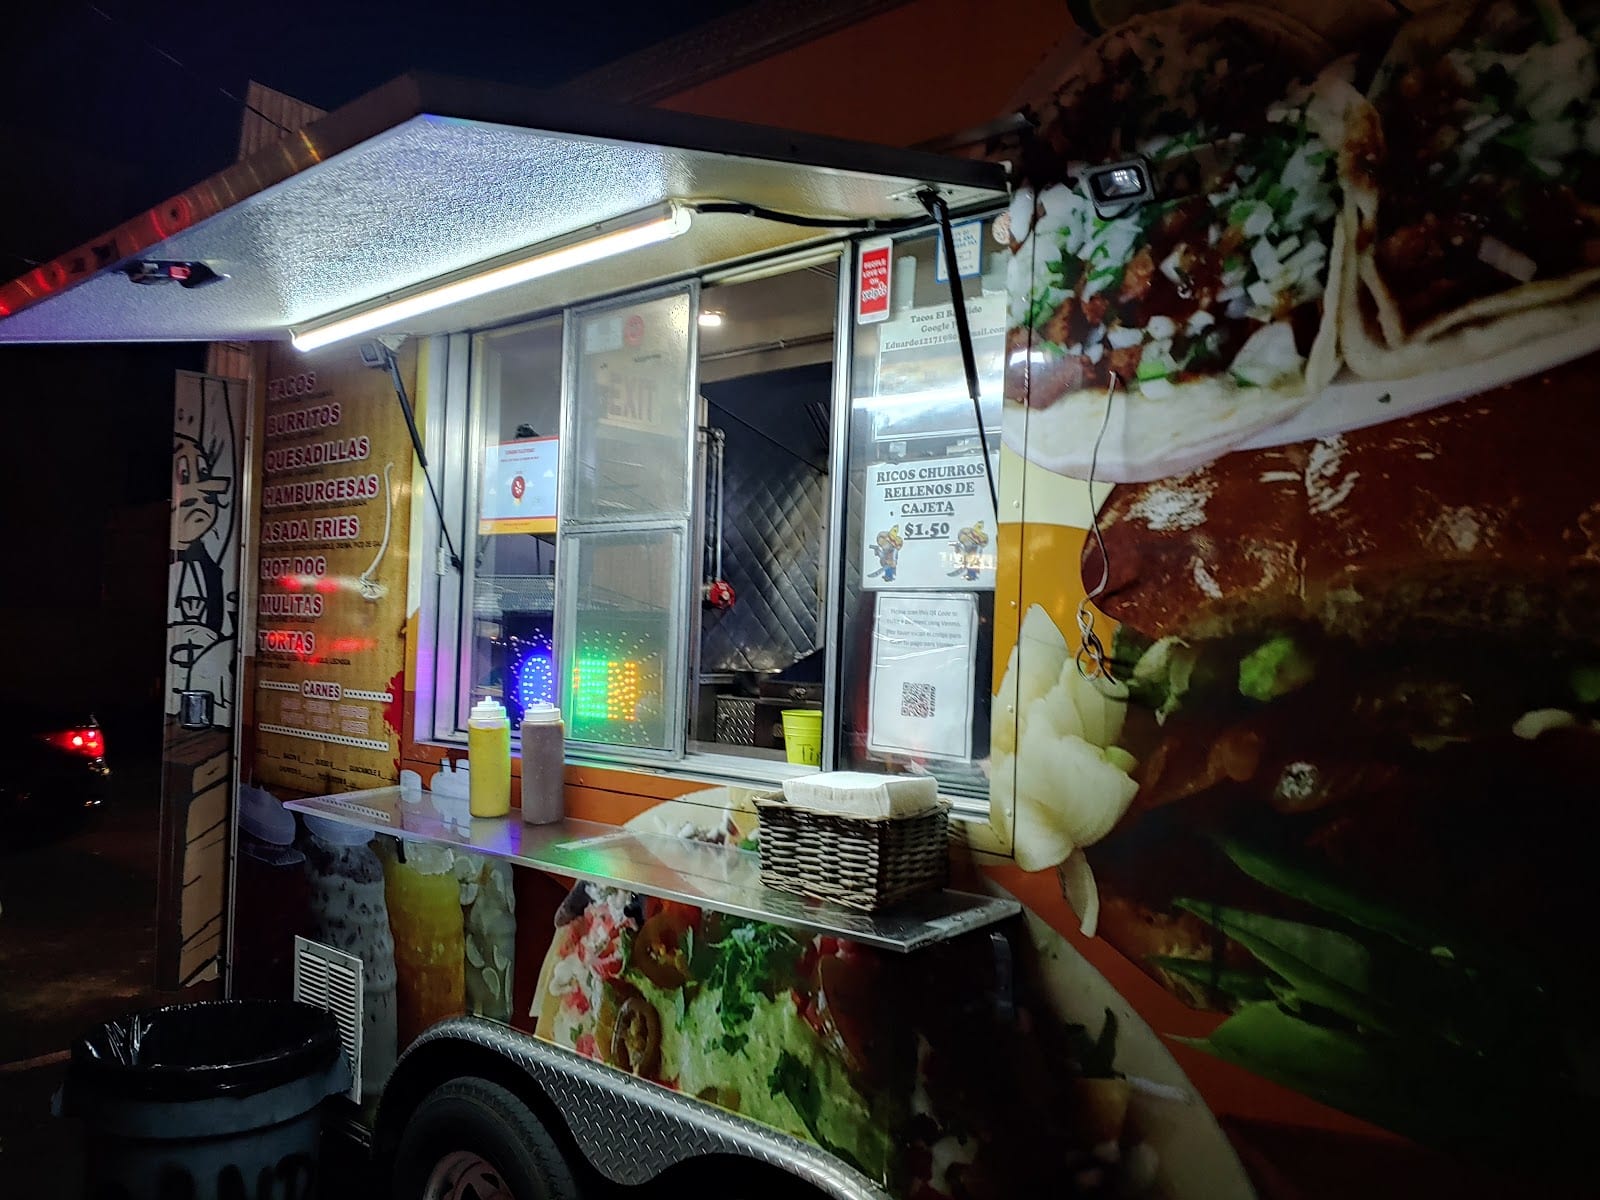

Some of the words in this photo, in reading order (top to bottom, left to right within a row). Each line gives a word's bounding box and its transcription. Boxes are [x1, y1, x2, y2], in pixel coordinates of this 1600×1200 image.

[911, 313, 934, 323] Tacos
[936, 311, 945, 319] El
[921, 322, 949, 334] Google
[270, 372, 316, 400] TACOS
[266, 403, 341, 436] BURRITOS
[265, 436, 370, 472] QUESADILLAS
[877, 469, 916, 482] RICOS
[918, 463, 985, 479] CHURROS
[263, 474, 379, 507] HAMBURGESAS
[884, 483, 953, 499] RELLENOS
[955, 482, 975, 494] DE
[901, 501, 955, 514] CAJETA
[262, 520, 311, 544] ASADA
[314, 515, 360, 540] FRIES
[904, 522, 950, 537] $1.50
[261, 557, 292, 579] HOT
[294, 556, 326, 579] DOG
[260, 594, 323, 617] MULITAS
[259, 630, 314, 654] TORTAS
[302, 681, 341, 700] CARNES
[522, 657, 638, 720] OEN
